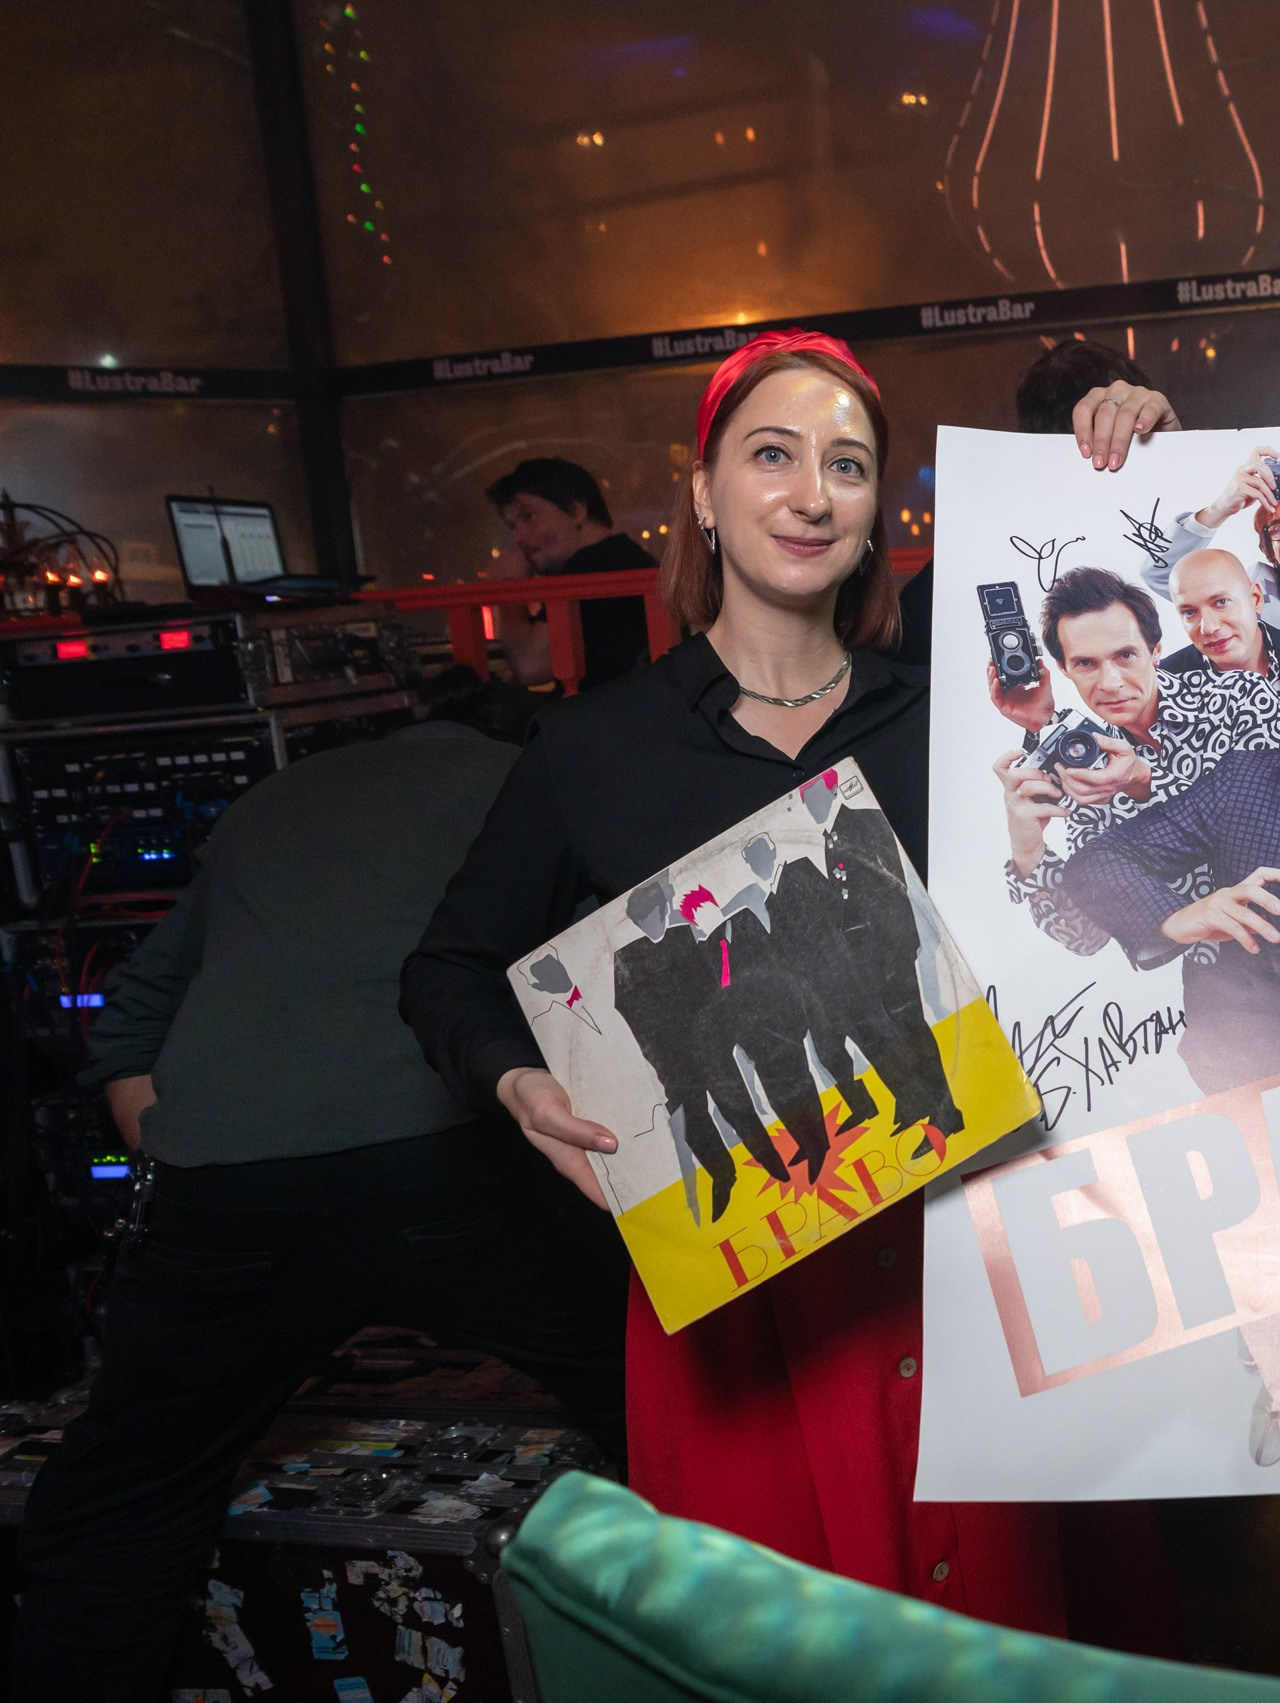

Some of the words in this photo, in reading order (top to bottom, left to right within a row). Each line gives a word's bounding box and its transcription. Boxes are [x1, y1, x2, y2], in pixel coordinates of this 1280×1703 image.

[920, 299, 1035, 328] #LustraBar
[433, 351, 534, 380] #LustraBar
[67, 369, 201, 392] #LustraBar
[713, 1123, 947, 1293] БРАВО
